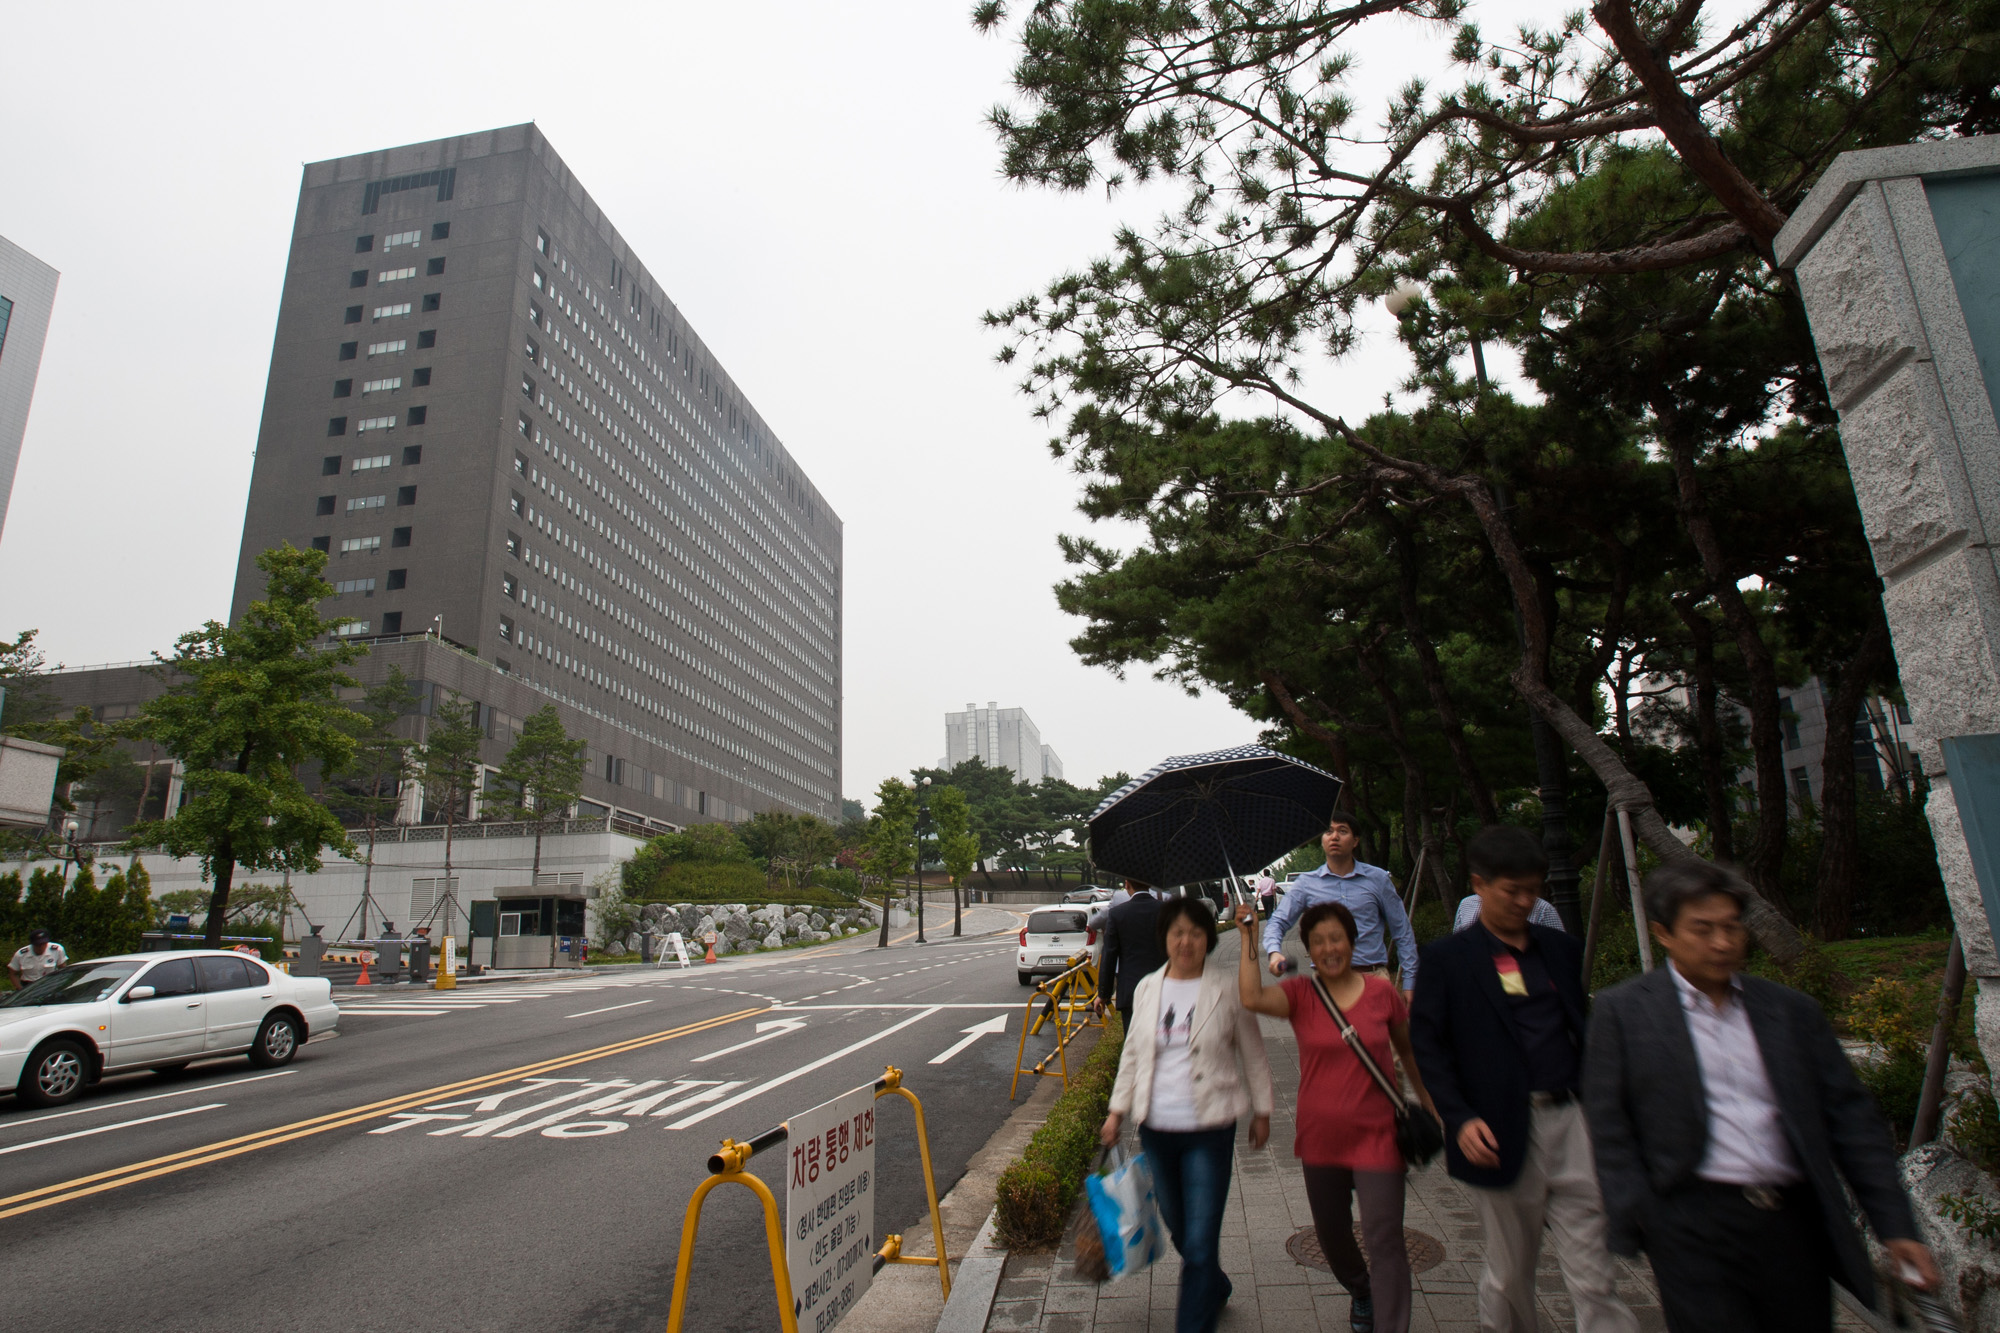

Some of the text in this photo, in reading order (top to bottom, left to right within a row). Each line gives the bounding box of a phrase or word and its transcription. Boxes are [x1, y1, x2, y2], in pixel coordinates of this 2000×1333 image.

[366, 1078, 750, 1138] 주차장
[792, 1107, 875, 1190] 차량 통행 제한
[816, 1192, 837, 1227] 반대편
[837, 1179, 856, 1211] 진입로
[815, 1234, 829, 1265] 인도
[830, 1221, 843, 1252] 출입
[844, 1213, 856, 1238] 가능
[804, 1266, 832, 1311] 제한시간
